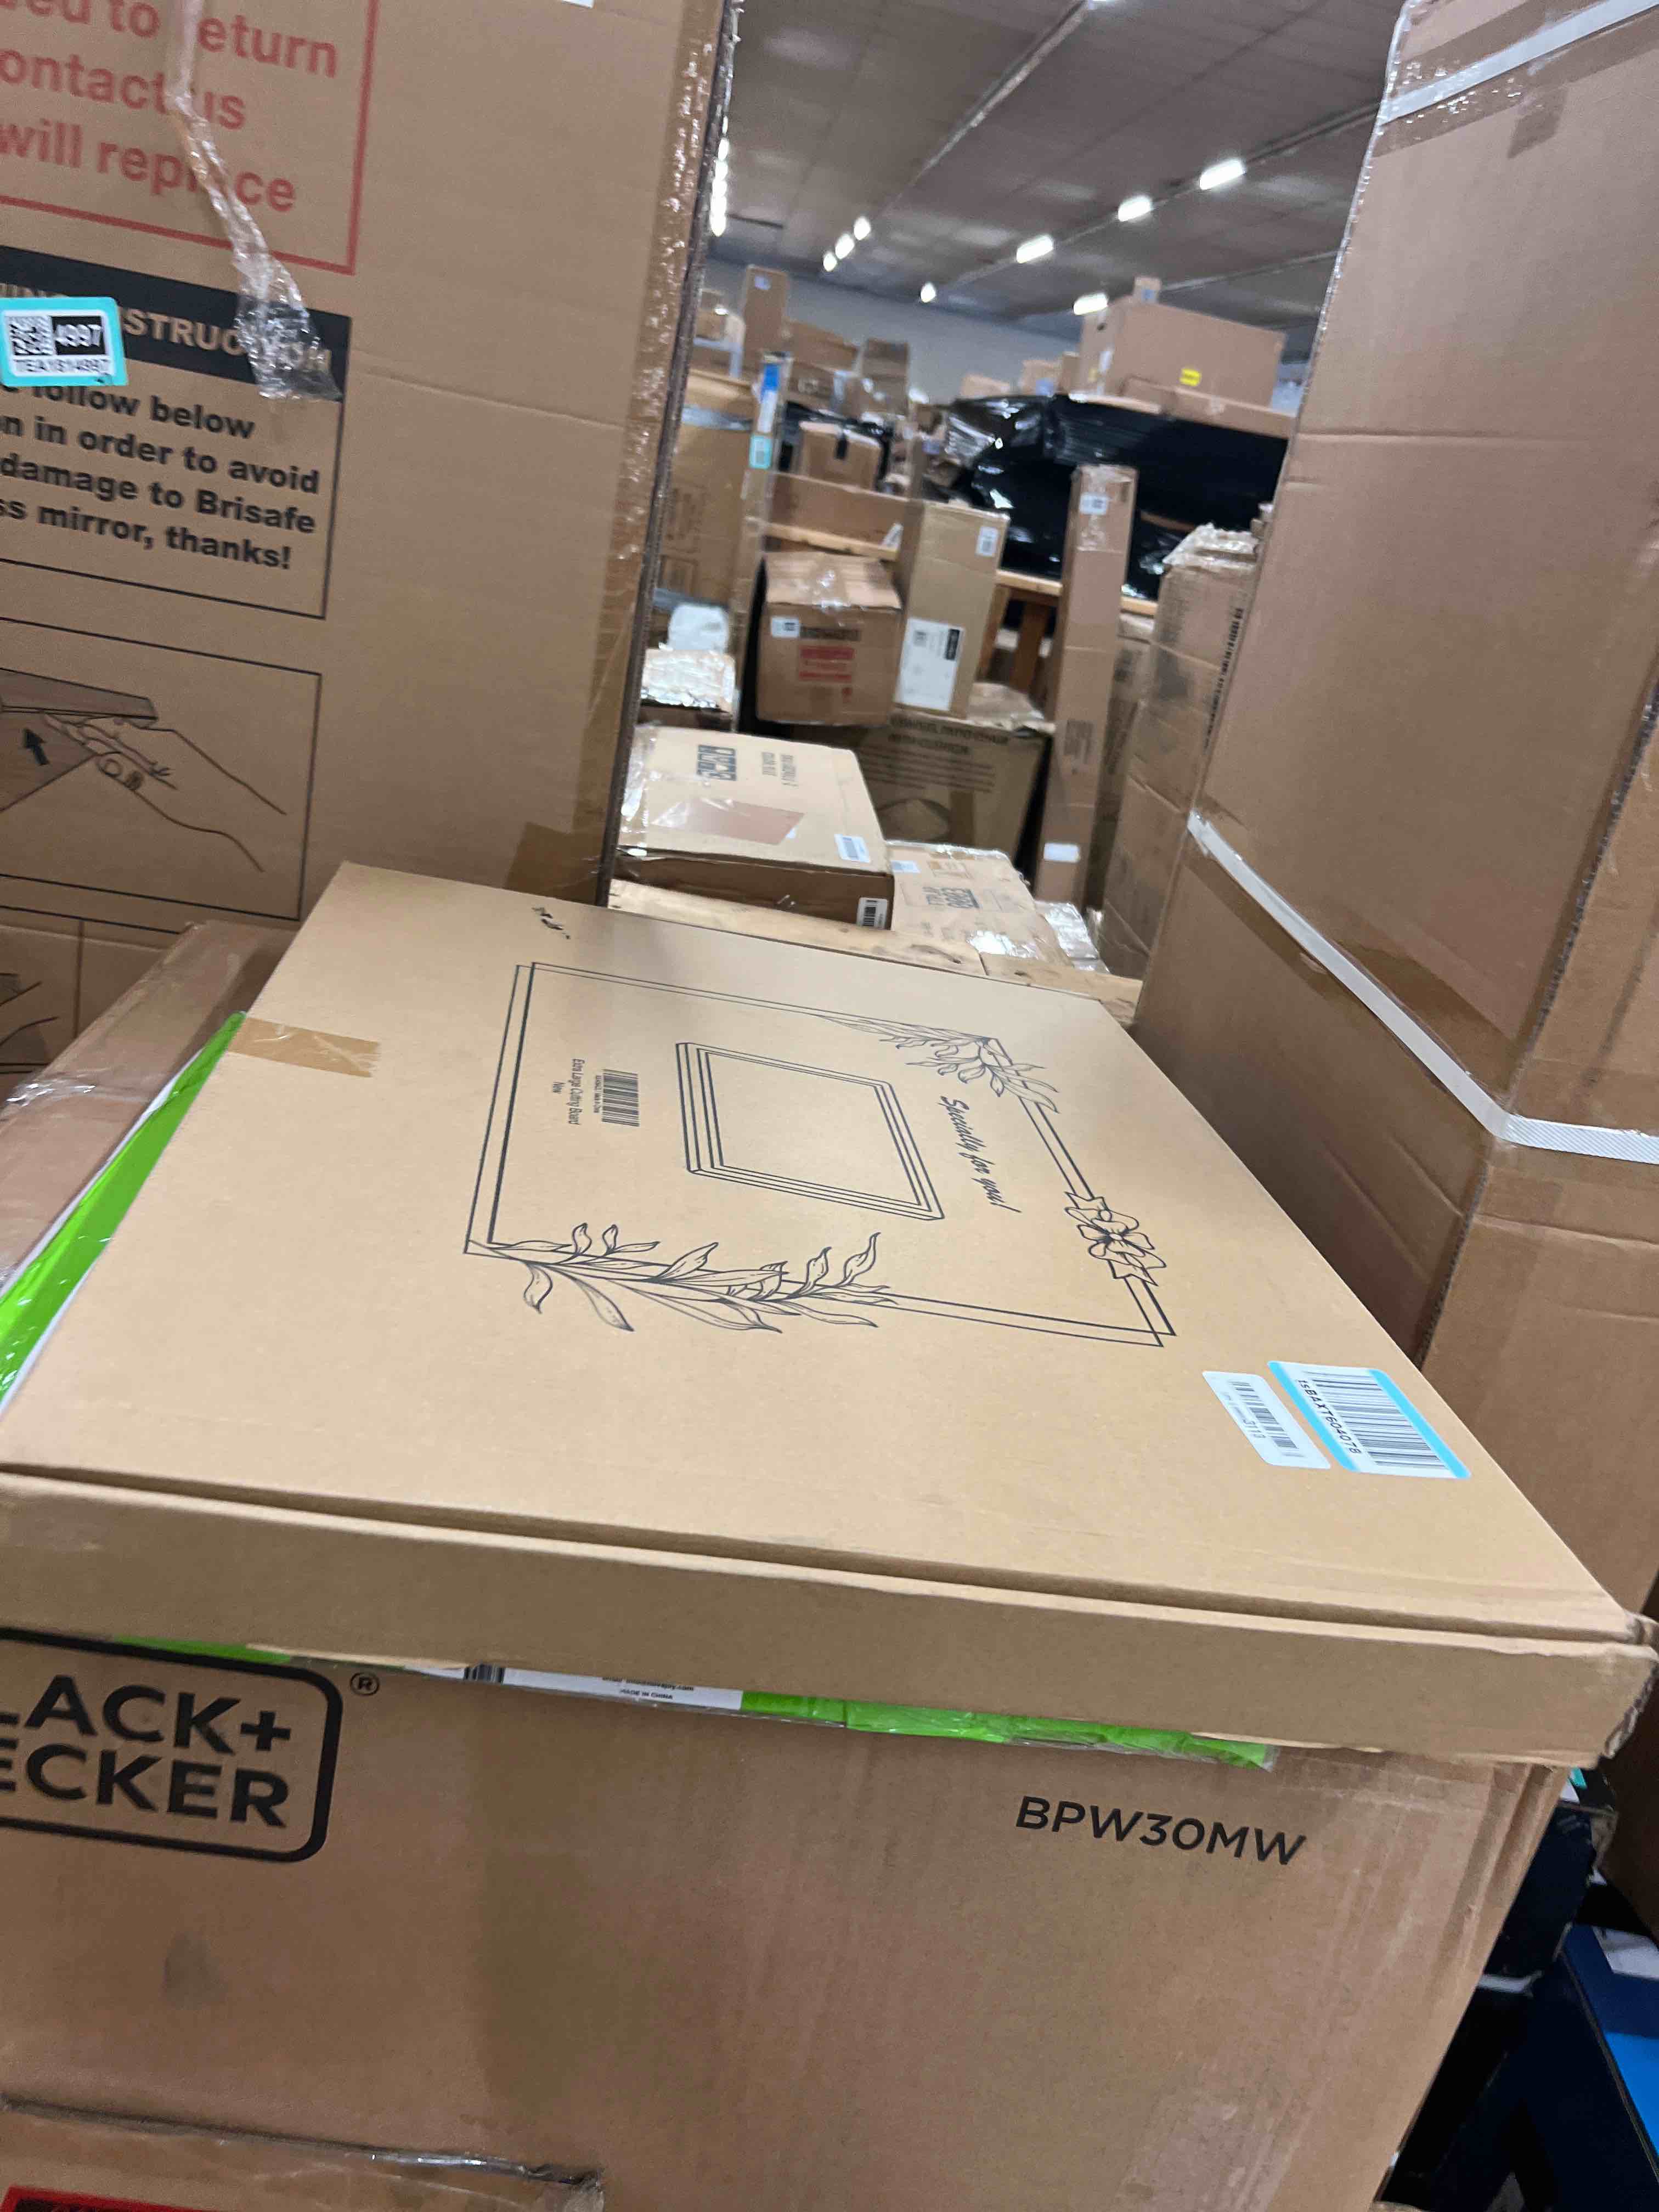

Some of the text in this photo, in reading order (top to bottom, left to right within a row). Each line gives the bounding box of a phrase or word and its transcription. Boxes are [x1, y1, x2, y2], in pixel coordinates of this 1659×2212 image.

[110, 0, 160, 38] to
[195, 15, 337, 78] eturn
[0, 118, 81, 168] will
[151, 396, 255, 438] below
[34, 415, 67, 445] in
[77, 430, 174, 465] order
[183, 447, 217, 474] to
[228, 460, 320, 495] avoid
[0, 453, 317, 534] damage to Brisafe
[37, 505, 155, 550] mirror,
[165, 525, 292, 570] thanks!
[568, 1072, 584, 1087] Large
[572, 1058, 585, 1072] Extra
[936, 1096, 987, 1152] Specially
[958, 1152, 996, 1175] for
[1016, 1795, 1307, 1865] BPW30MW
